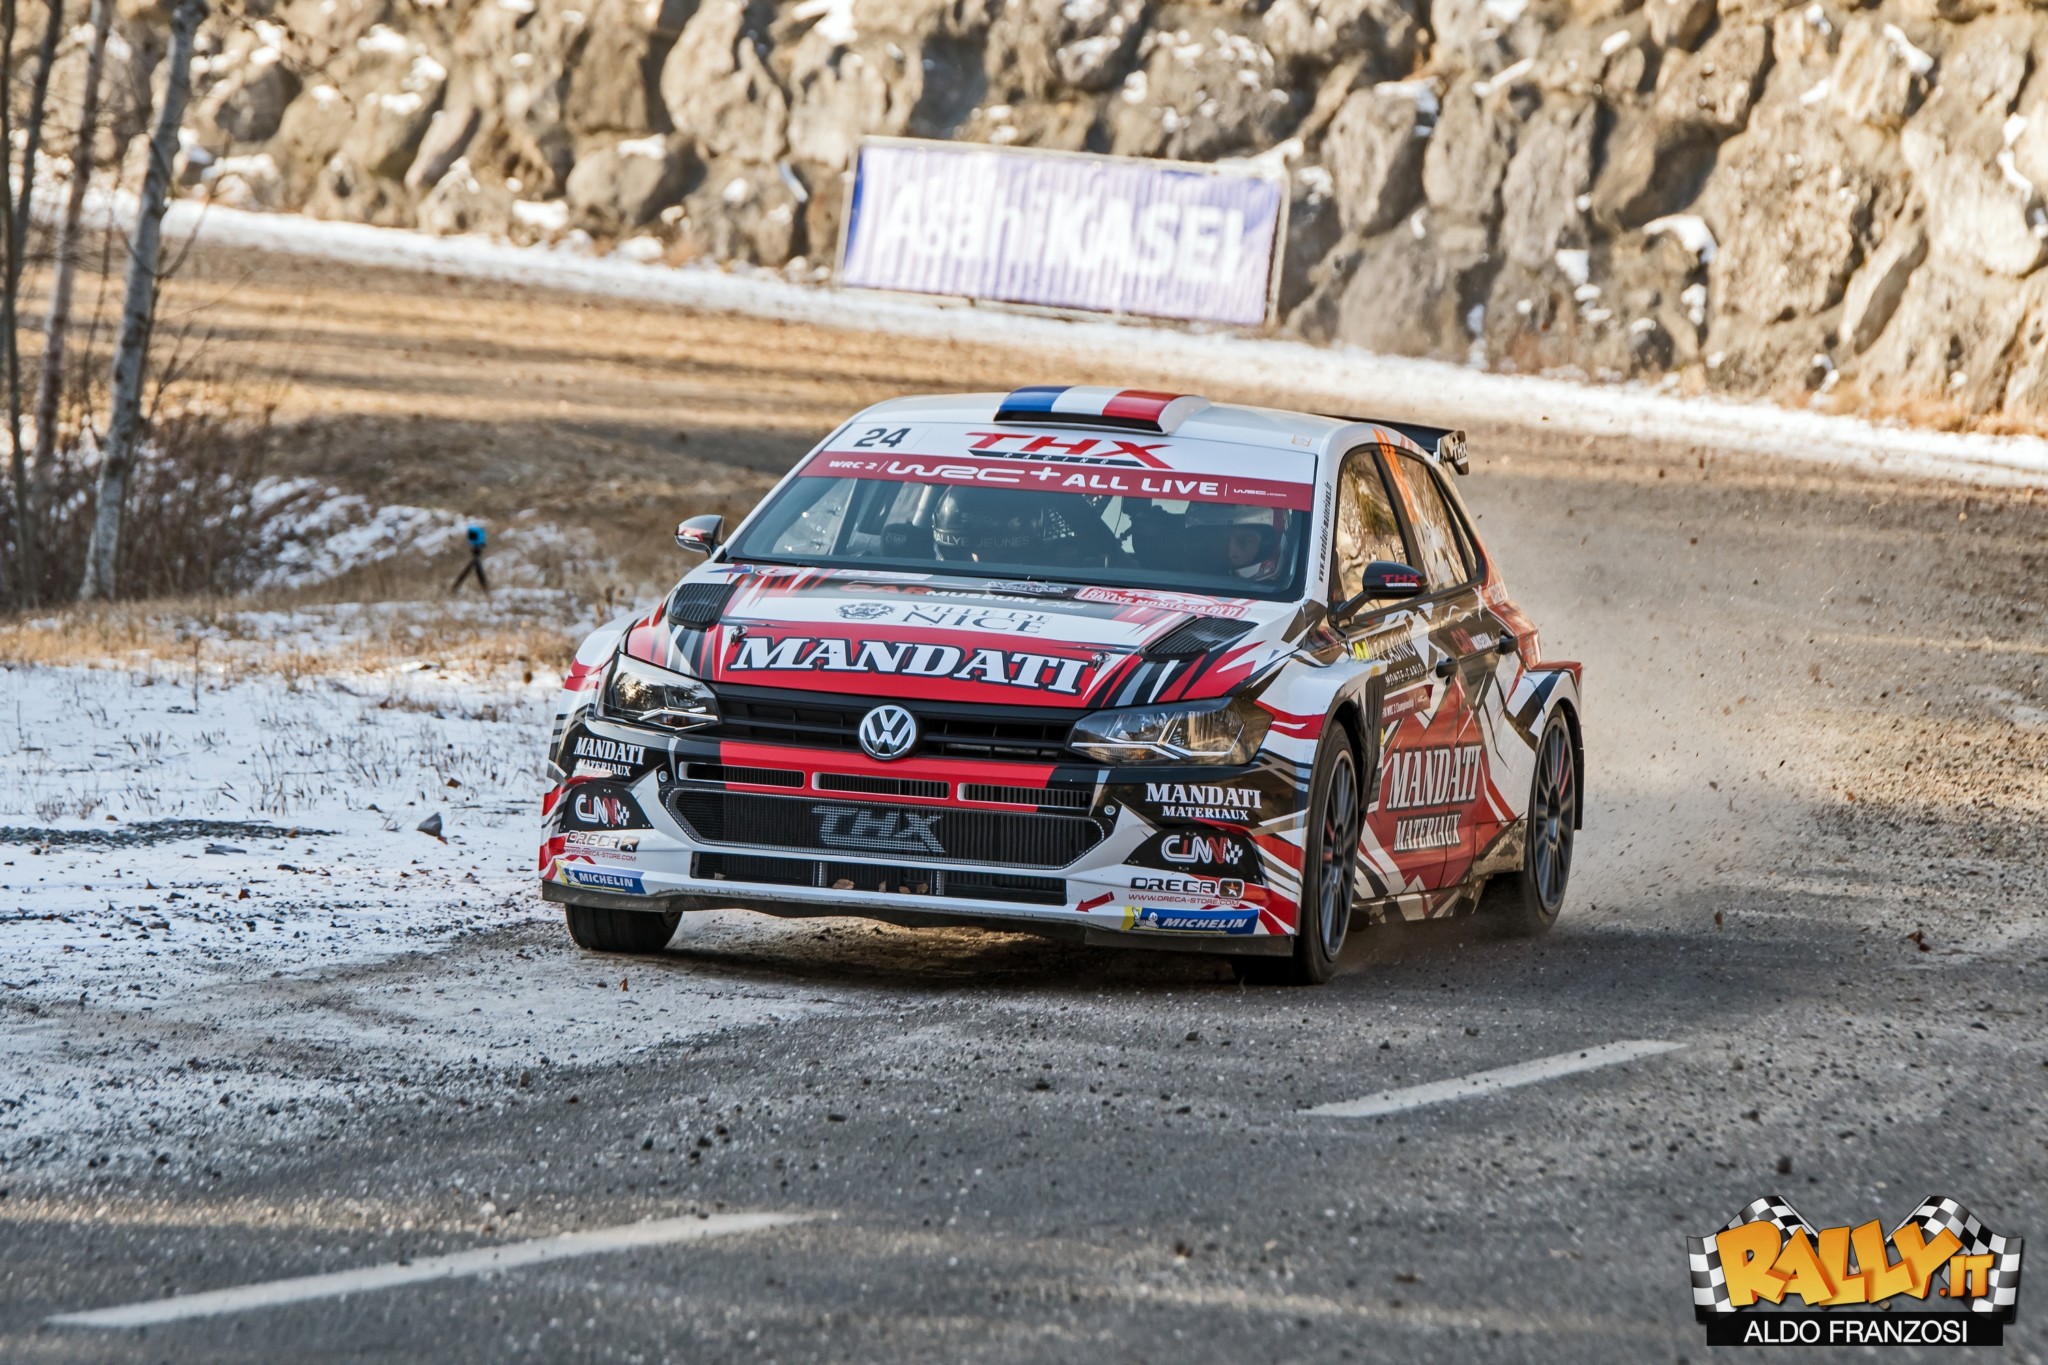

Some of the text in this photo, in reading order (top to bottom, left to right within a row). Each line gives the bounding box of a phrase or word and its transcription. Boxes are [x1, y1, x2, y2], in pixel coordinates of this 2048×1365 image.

[853, 427, 911, 448] 24
[965, 431, 1175, 470] THX
[1002, 451, 1109, 465] RACING
[829, 460, 864, 469] WRC
[865, 462, 878, 470] 2
[1062, 473, 1129, 490] ALL
[1140, 478, 1219, 496] LIVE
[1381, 574, 1422, 587] THX
[926, 590, 1039, 604] MUSEUM
[902, 611, 1046, 634] NICE
[912, 604, 1053, 622] VILLE DE
[730, 637, 1090, 693] MANDATI
[573, 736, 646, 765] MANDATI
[576, 758, 631, 777] MATERIAUX
[1387, 745, 1482, 809] MANDATI
[1145, 782, 1262, 809] MANDATI
[1162, 805, 1249, 821] MATERIAUX
[811, 805, 947, 853] THX
[1393, 813, 1462, 851] MATERIAUX
[566, 830, 620, 849] ORECA
[577, 872, 634, 888] MICHELIN
[1130, 877, 1217, 894] ORECA
[1128, 893, 1240, 907] WWW.ORECA-STORE.COM
[1162, 917, 1248, 929] MICHELIN
